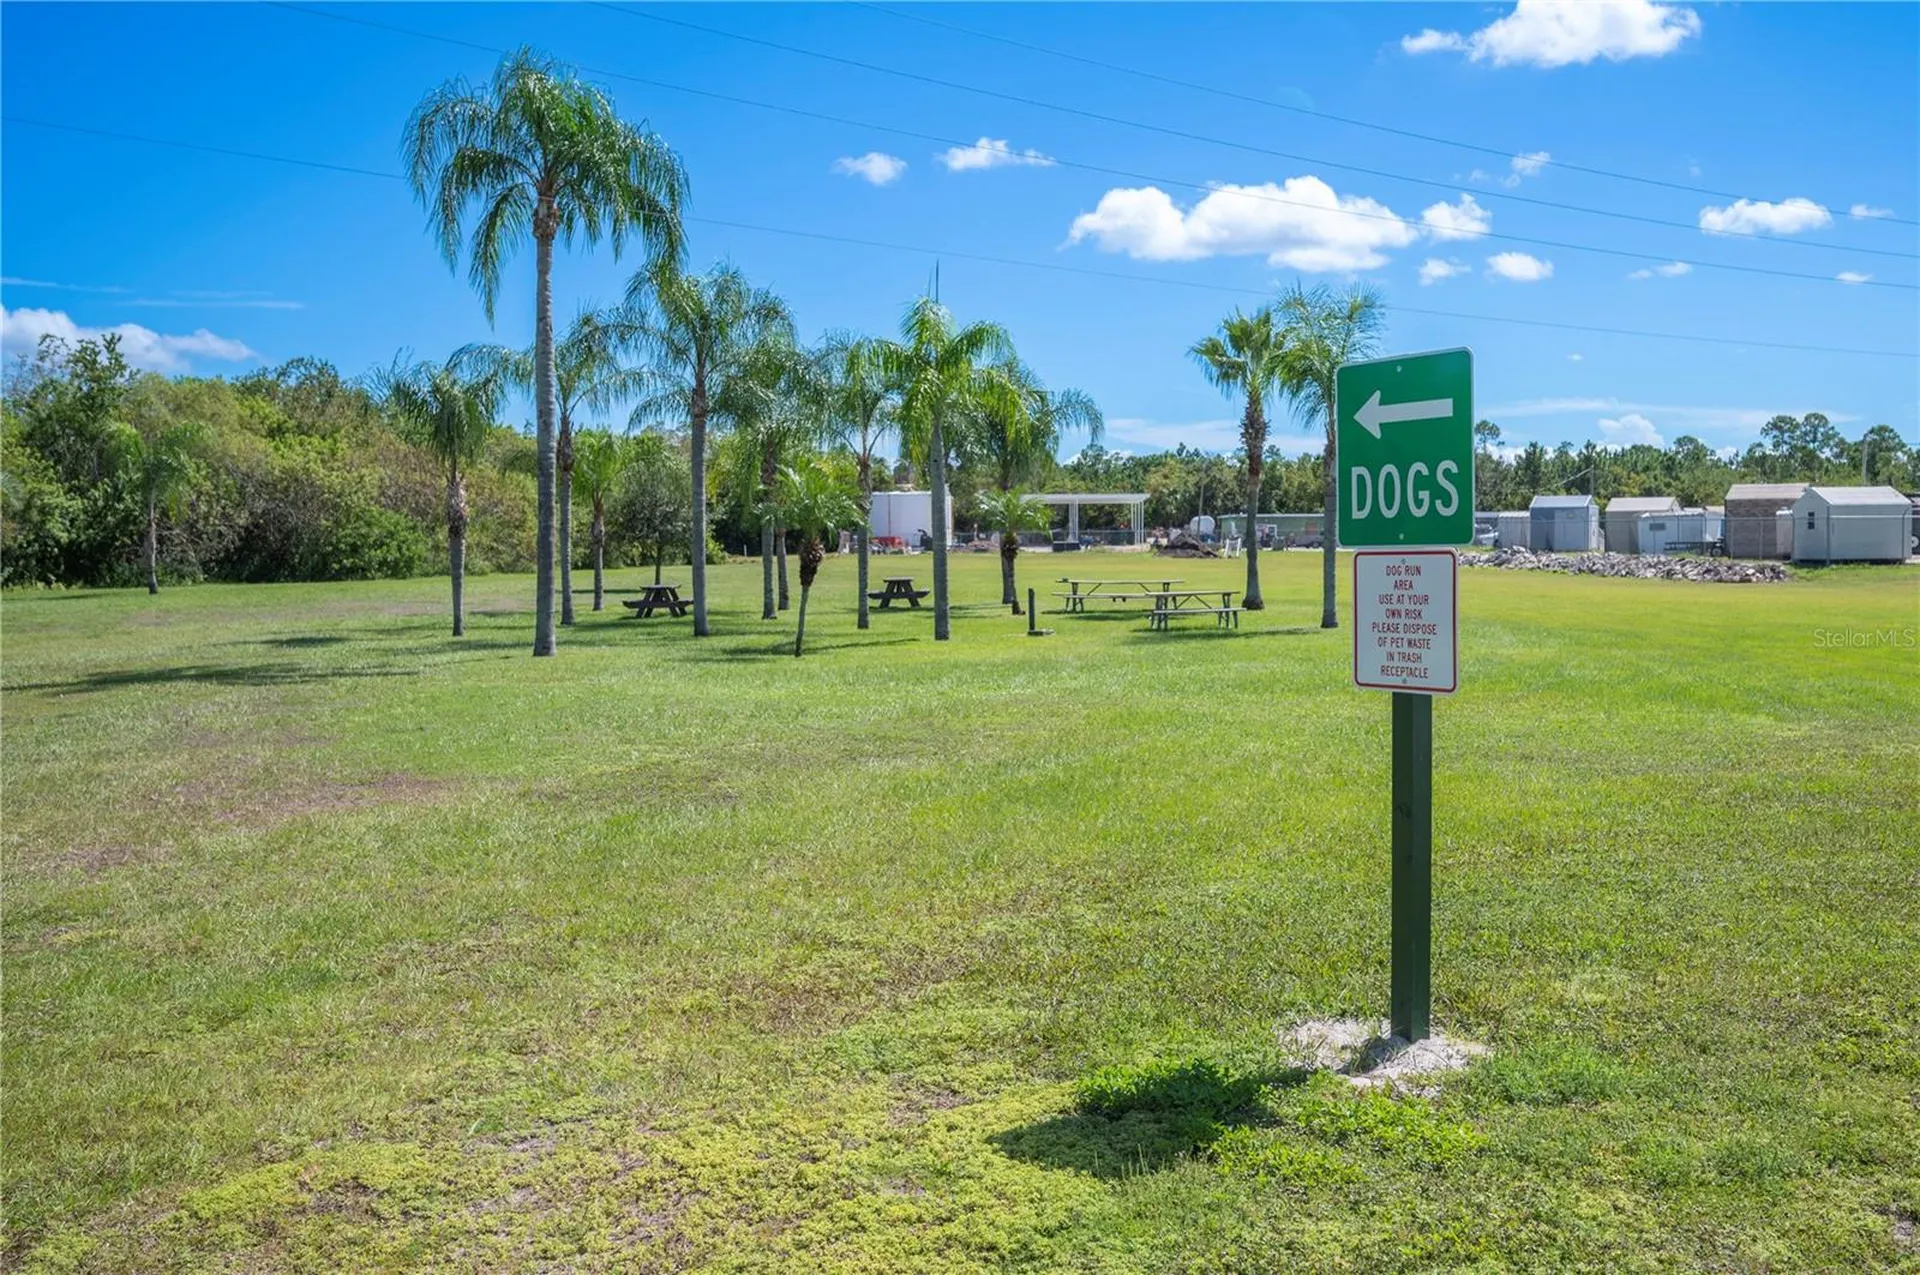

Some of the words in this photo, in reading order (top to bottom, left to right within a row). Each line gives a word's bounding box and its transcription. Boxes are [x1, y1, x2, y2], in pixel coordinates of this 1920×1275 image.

[1351, 459, 1459, 519] DOGS
[1386, 566, 1402, 576] DOG
[1405, 566, 1421, 576] RUN
[1394, 580, 1413, 590] AREA
[1379, 594, 1393, 605] USE
[1396, 594, 1405, 605] AT
[1408, 594, 1429, 605] YOUR
[1385, 609, 1402, 619] OWN
[1405, 609, 1422, 620] RISK
[1372, 622, 1400, 634] PLEASE
[1403, 623, 1437, 635] DISPOSE
[1377, 637, 1388, 647] OF
[1390, 637, 1404, 648] PET
[1407, 638, 1431, 650] WASTE
[1386, 651, 1395, 662] IN
[1398, 652, 1422, 664] TRASH
[1380, 666, 1429, 679] RECEPTACLE
